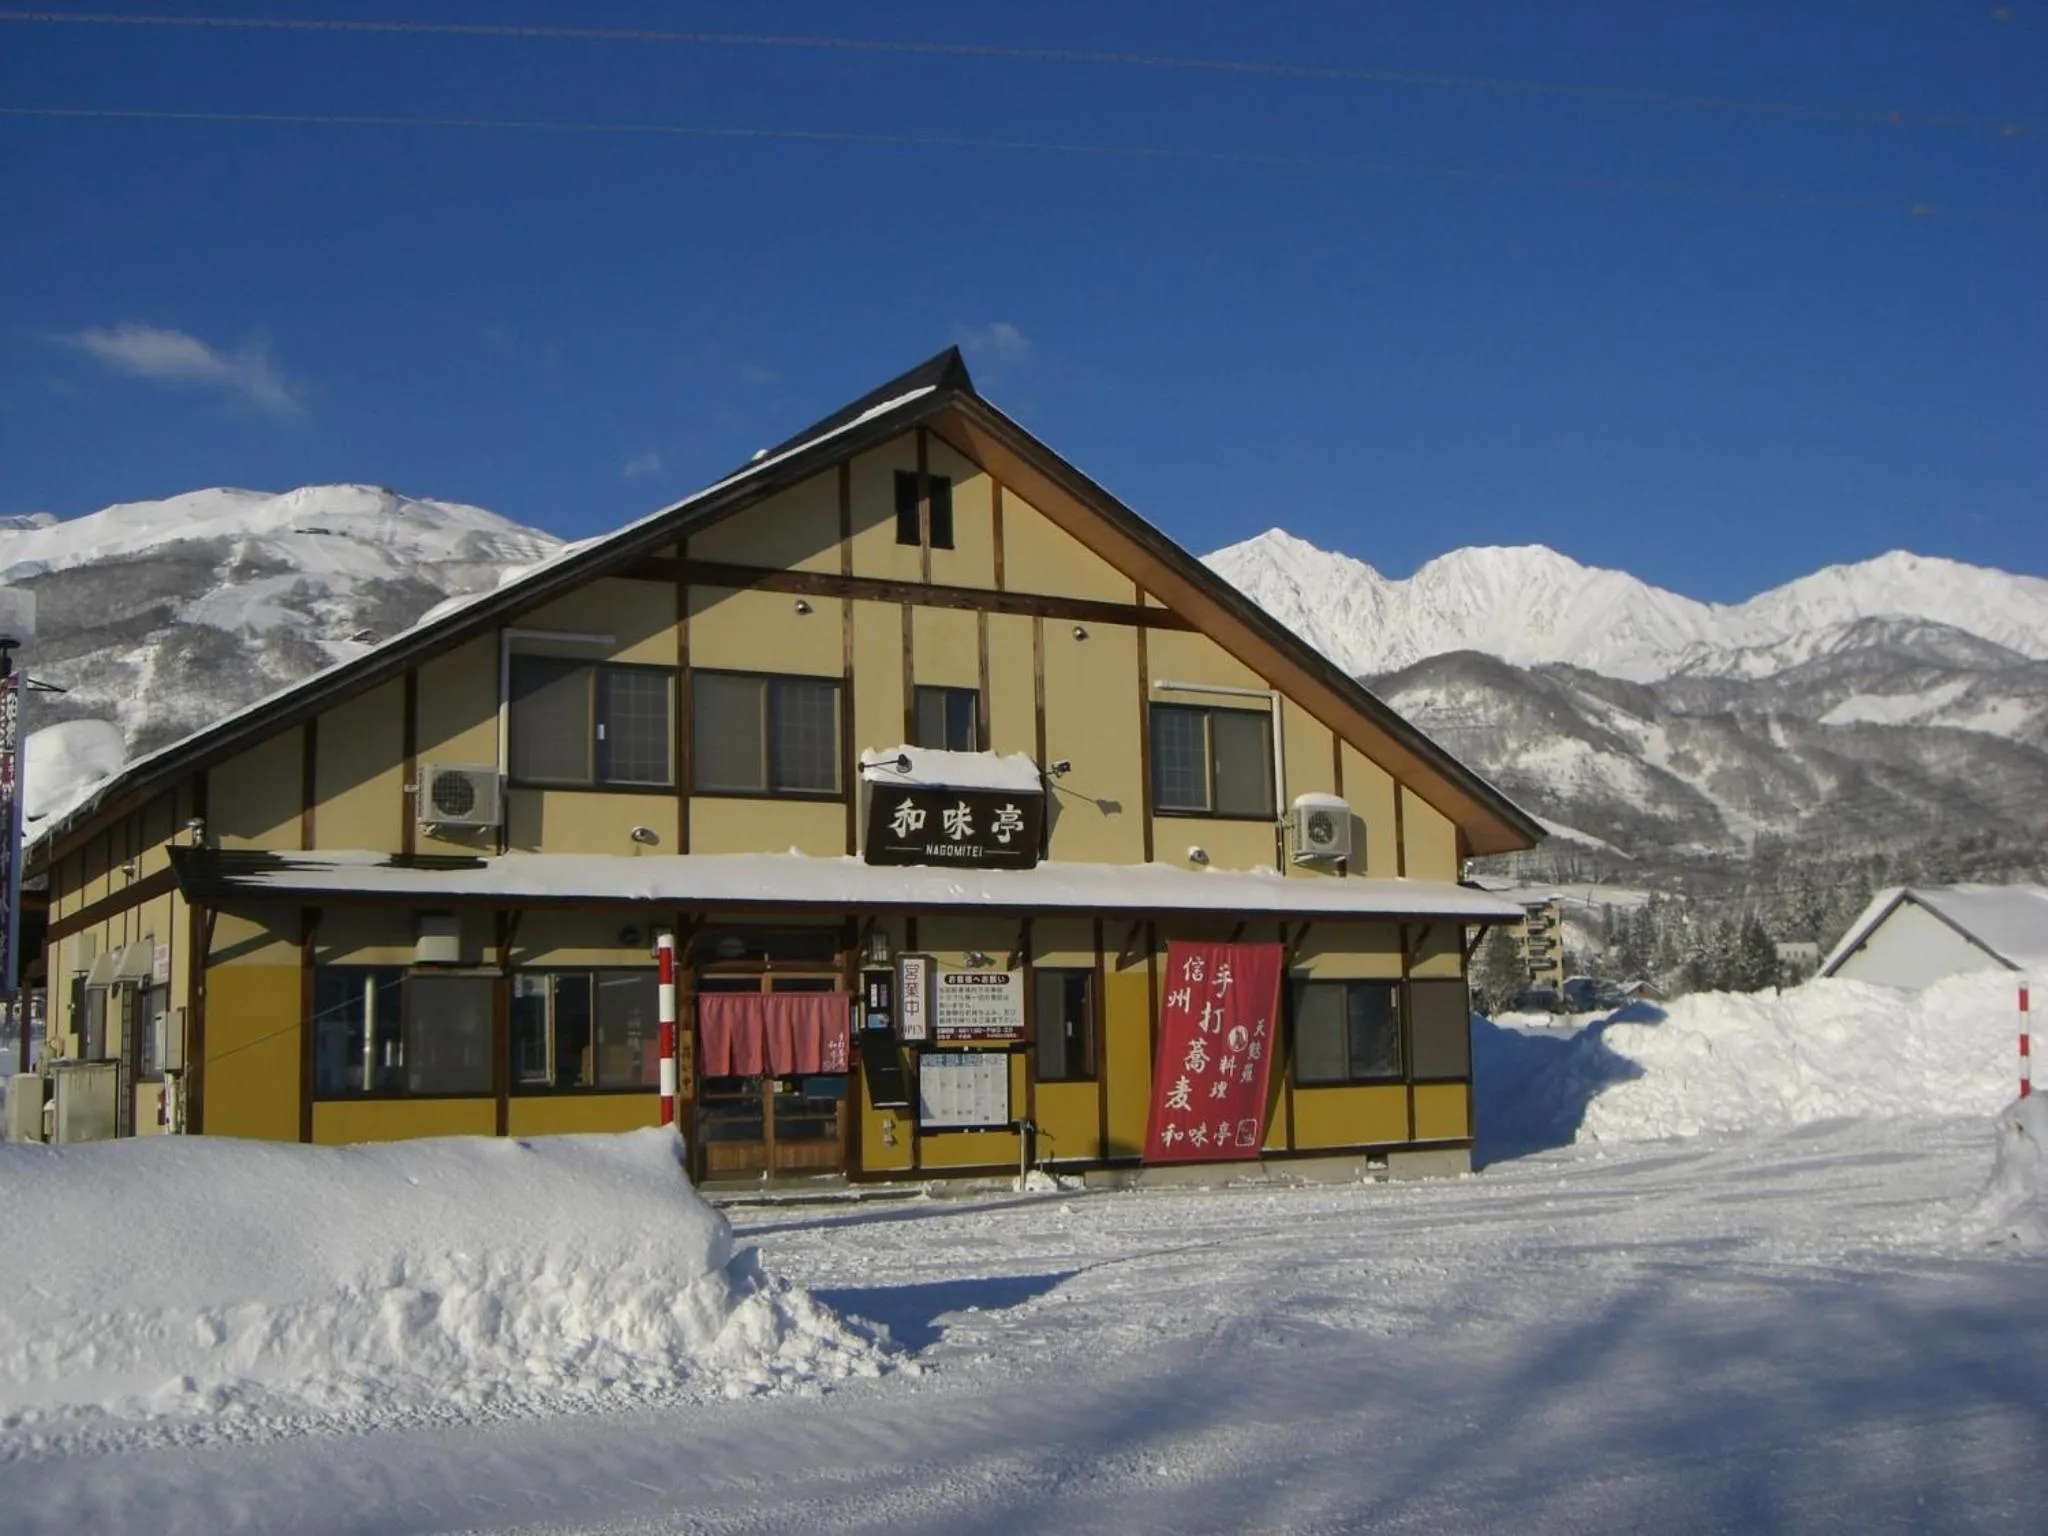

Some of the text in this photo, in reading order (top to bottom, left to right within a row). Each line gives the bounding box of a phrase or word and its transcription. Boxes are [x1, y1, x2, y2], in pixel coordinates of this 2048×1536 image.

[888, 797, 1024, 844] 和味亭
[925, 844, 984, 857] NAGOMITEI
[904, 963, 919, 1017] 営業中
[1167, 956, 1206, 1014] 信州
[1164, 965, 1235, 1112] 手打蕎麦
[1160, 1119, 1233, 1148] 和味亭
